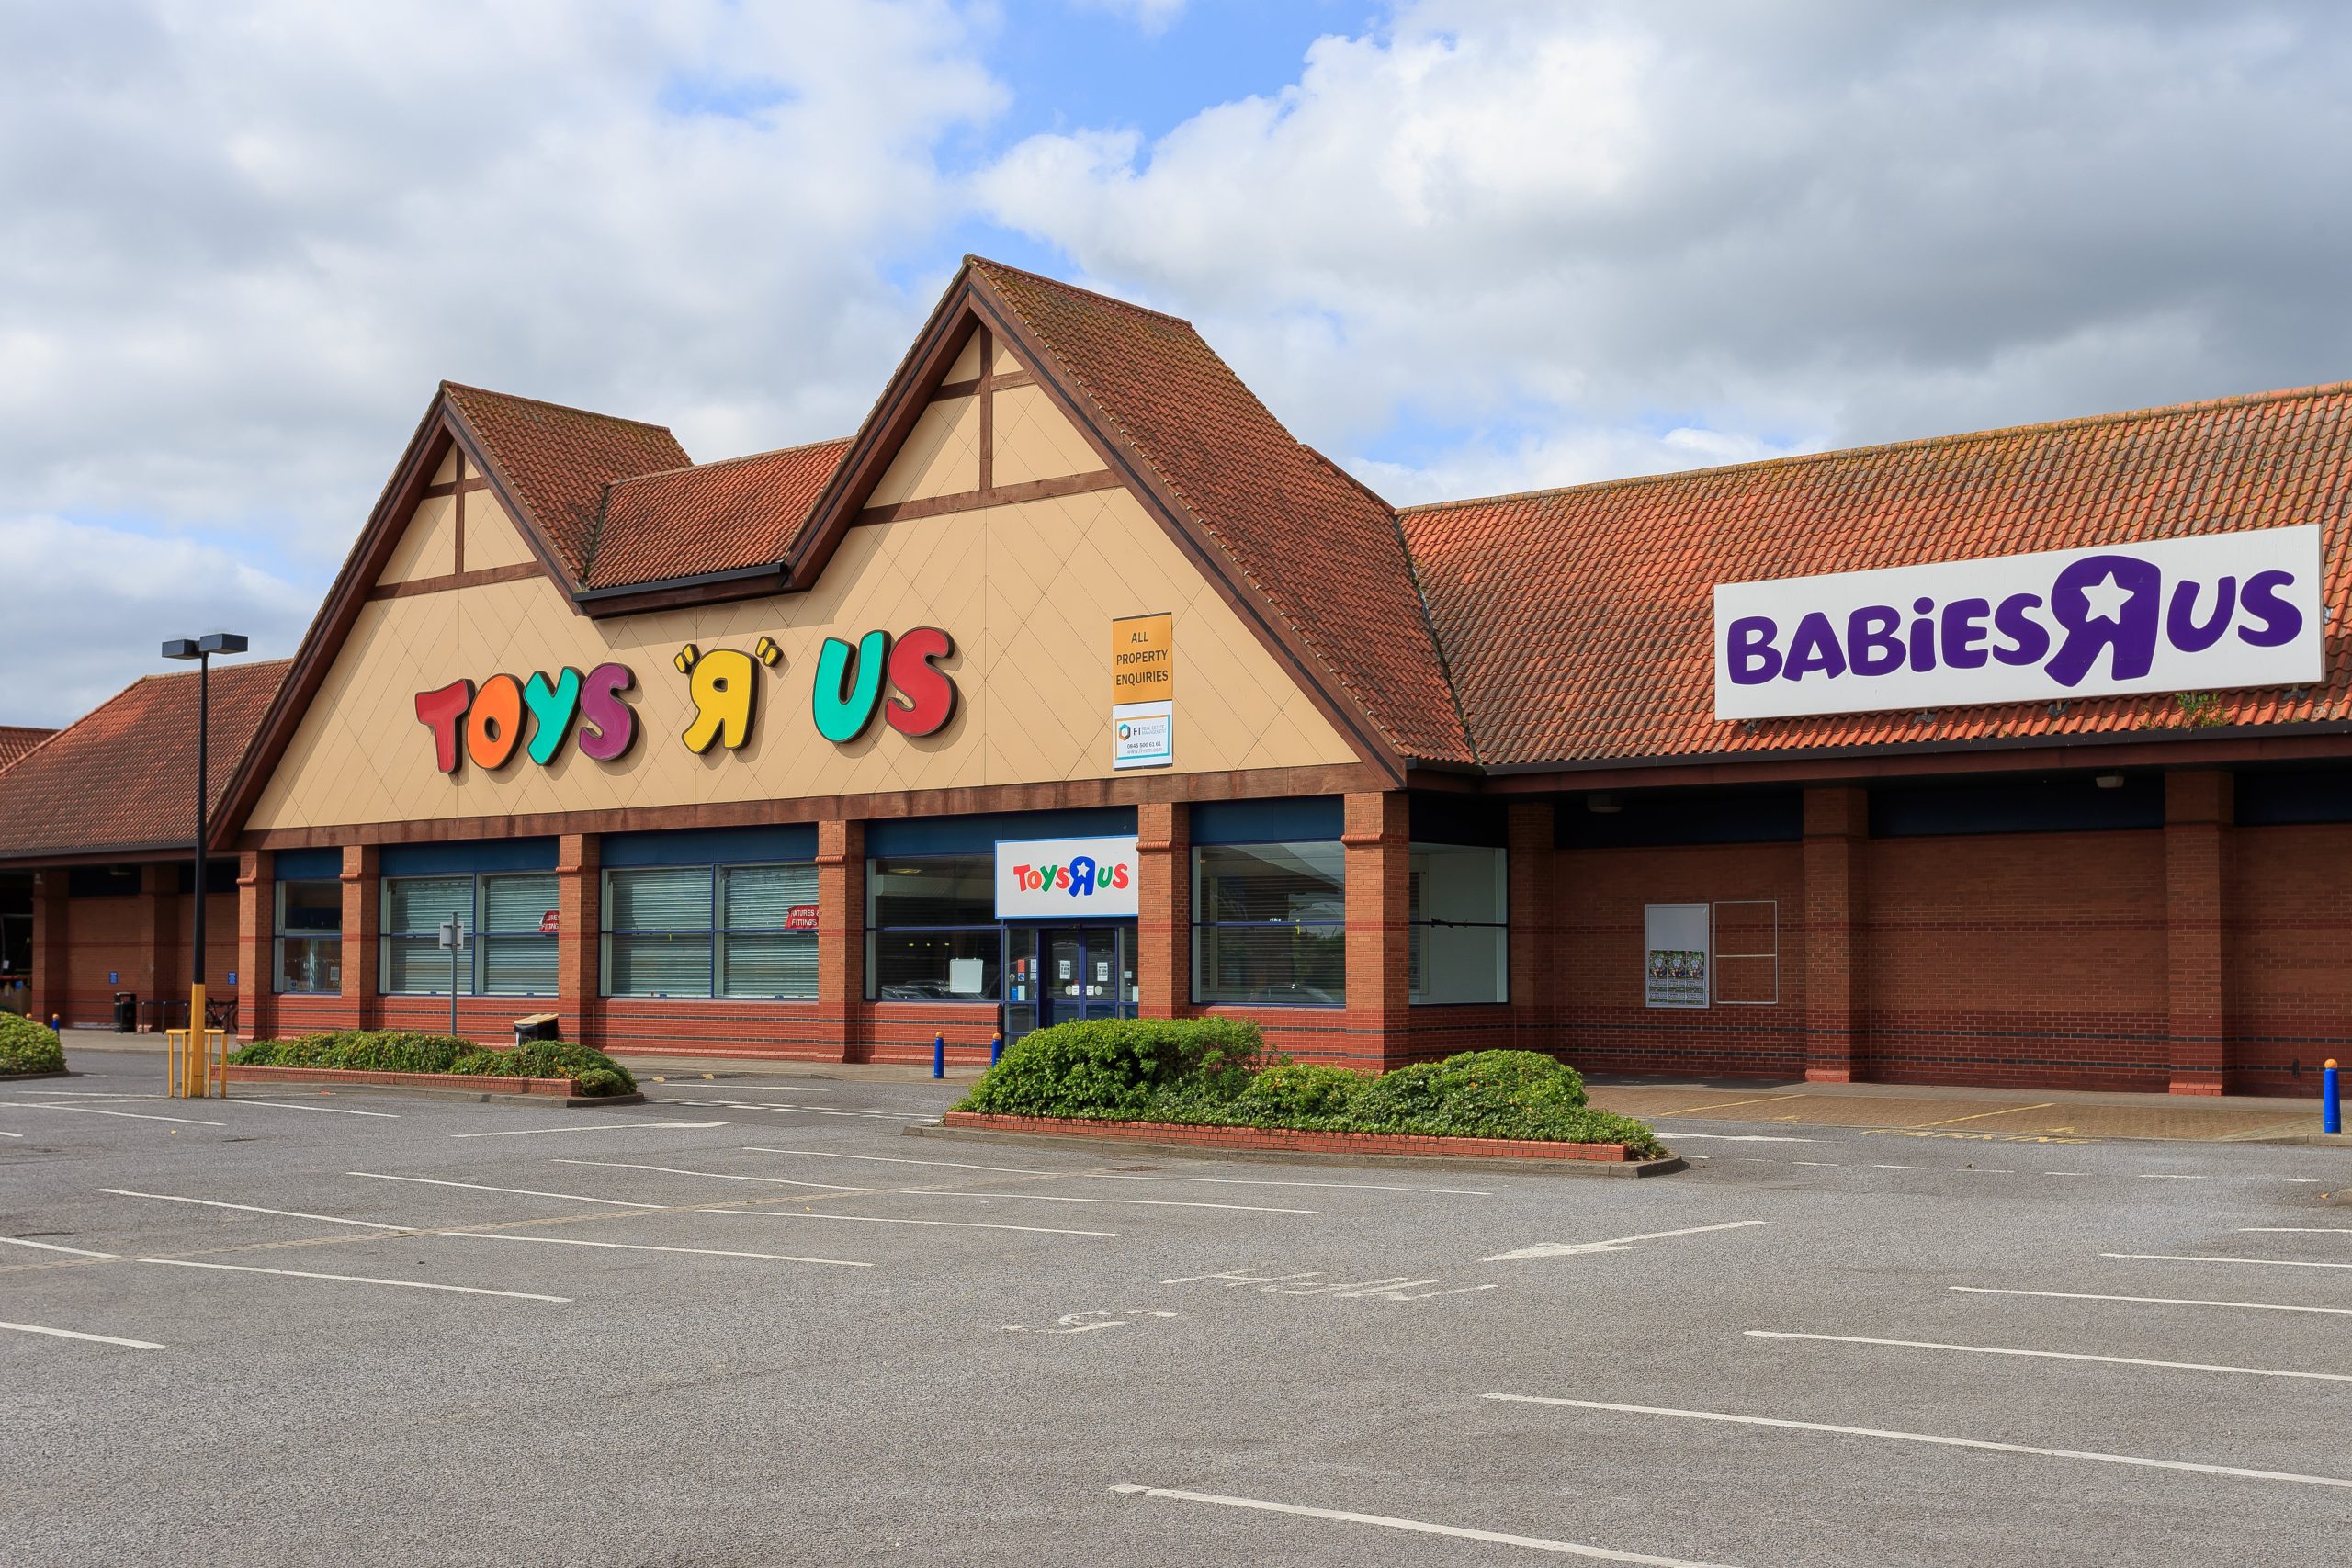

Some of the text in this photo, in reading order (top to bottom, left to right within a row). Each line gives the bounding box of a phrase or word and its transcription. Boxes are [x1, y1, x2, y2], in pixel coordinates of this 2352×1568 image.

[2166, 570, 2303, 653] US
[1131, 632, 1148, 643] ALL
[1116, 649, 1169, 665] PROPERTY
[1116, 670, 1169, 686] ENQUIRIES
[415, 662, 636, 774] TOYS
[812, 626, 958, 744] US
[1133, 727, 1141, 736] FI
[1097, 863, 1129, 890] US
